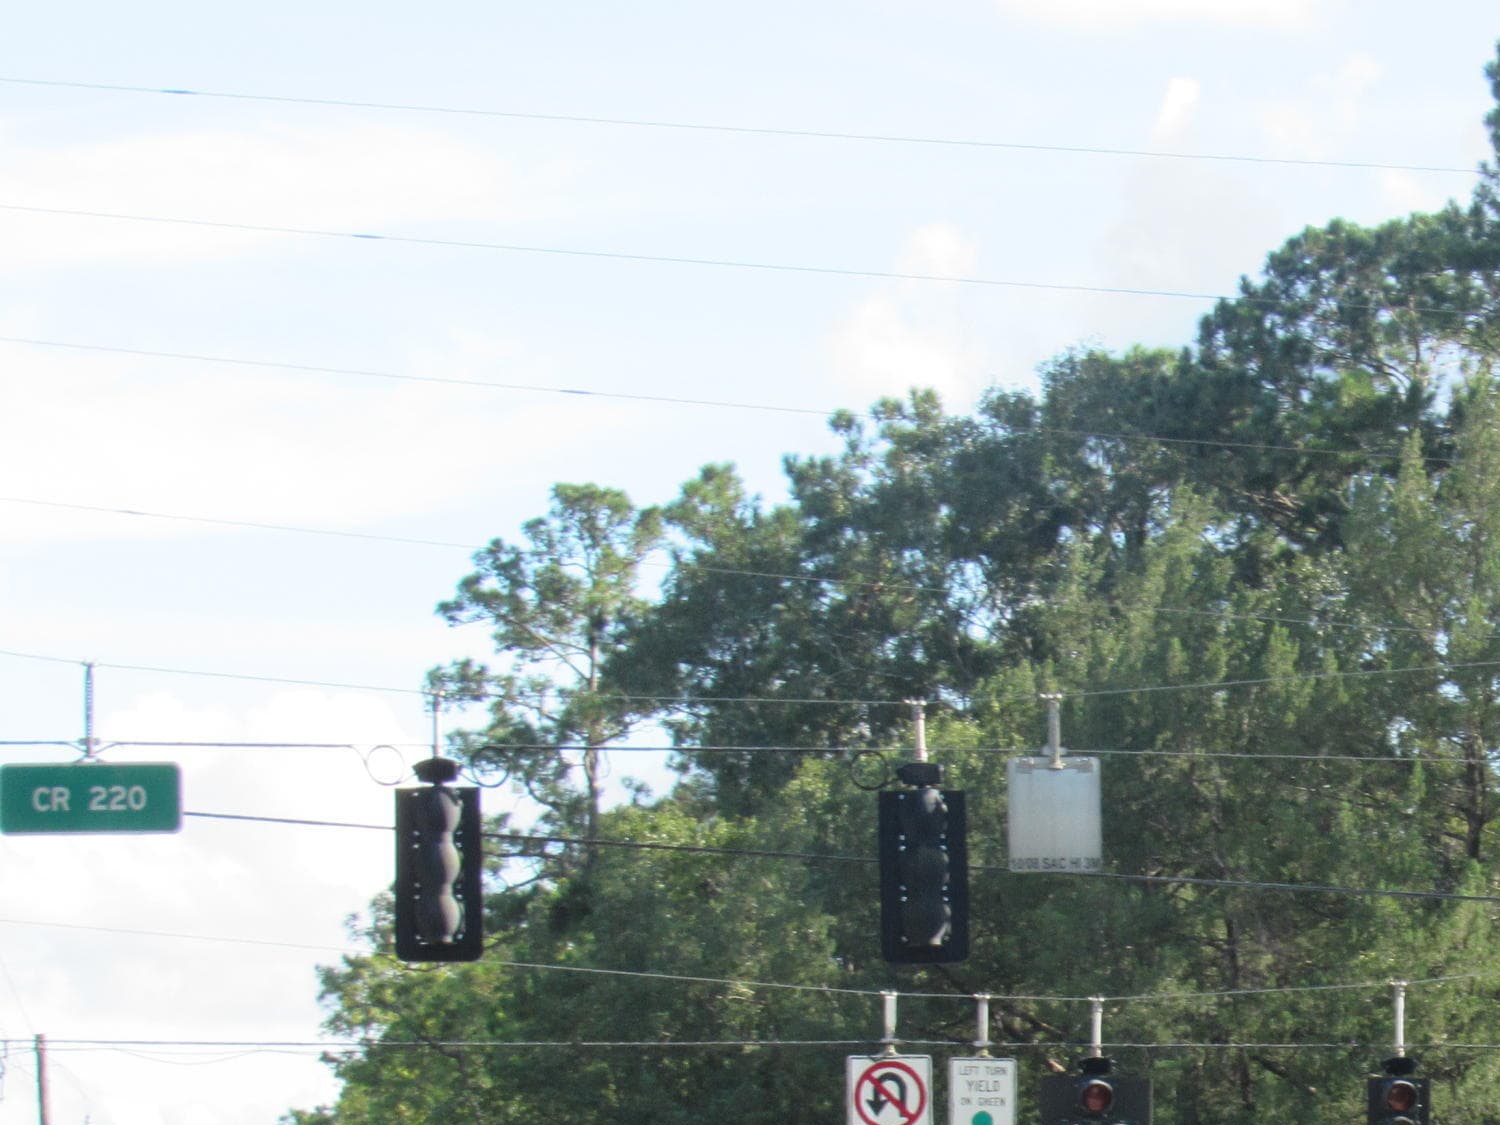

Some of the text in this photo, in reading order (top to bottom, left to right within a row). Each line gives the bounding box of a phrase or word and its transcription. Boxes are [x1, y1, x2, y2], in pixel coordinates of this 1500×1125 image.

[32, 785, 147, 811] CR 220
[959, 1066, 980, 1075] LEFT
[966, 1080, 1000, 1092] YIELD
